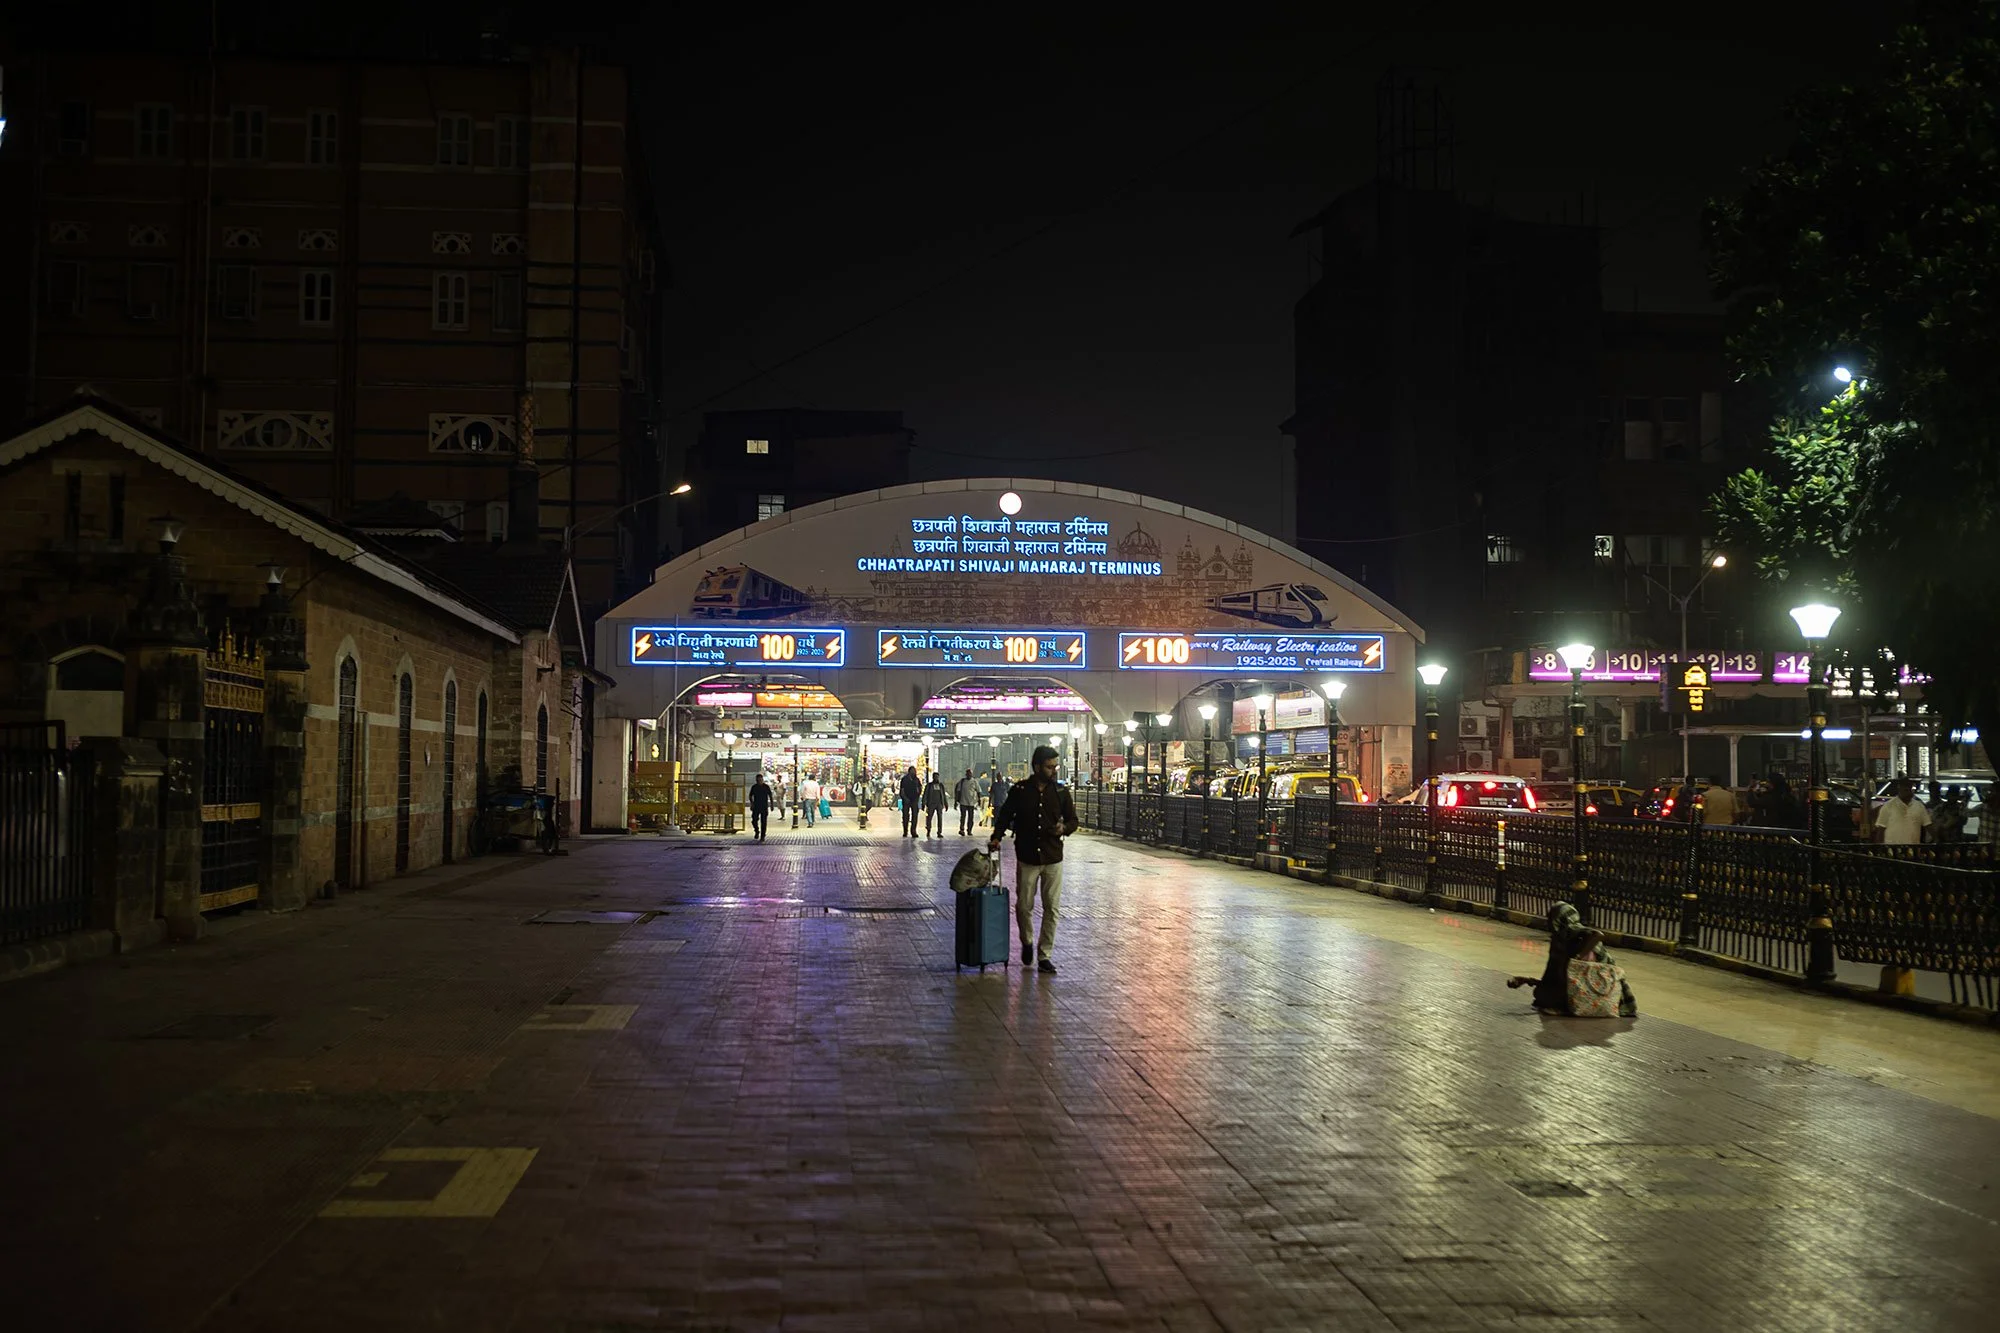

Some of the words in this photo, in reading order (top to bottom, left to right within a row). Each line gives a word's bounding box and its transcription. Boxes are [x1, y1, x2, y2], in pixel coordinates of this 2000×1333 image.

[912, 515, 957, 533] छत्रपती
[962, 515, 1011, 534] शिवाजी
[1015, 521, 1060, 537] महाराज
[1064, 517, 1108, 535] टर्मिनस
[912, 536, 957, 553] छत्रपति
[962, 535, 1010, 553] शिवाजी
[1014, 541, 1059, 557] महाराज
[1063, 537, 1107, 555] टर्मिनस
[857, 558, 955, 572] CHHATRAPATI
[959, 559, 1014, 573] SHIVAJI
[1018, 560, 1085, 574] MAHARAJ
[1090, 561, 1162, 576] TERMINUS
[760, 634, 795, 660] 100
[992, 636, 1004, 650] के
[1004, 636, 1038, 663] 100
[1142, 638, 1190, 664] 100
[1211, 641, 1220, 651] of
[1221, 638, 1272, 654] Railway
[1237, 655, 1296, 666] 1925-2025
[1305, 657, 1333, 666] Central
[1334, 657, 1363, 667] Railway
[1544, 654, 1557, 671] 8
[1619, 654, 1642, 672] 10
[1734, 654, 1757, 671] 13
[1786, 655, 1811, 674] 14
[1092, 759, 1115, 767] Slon
